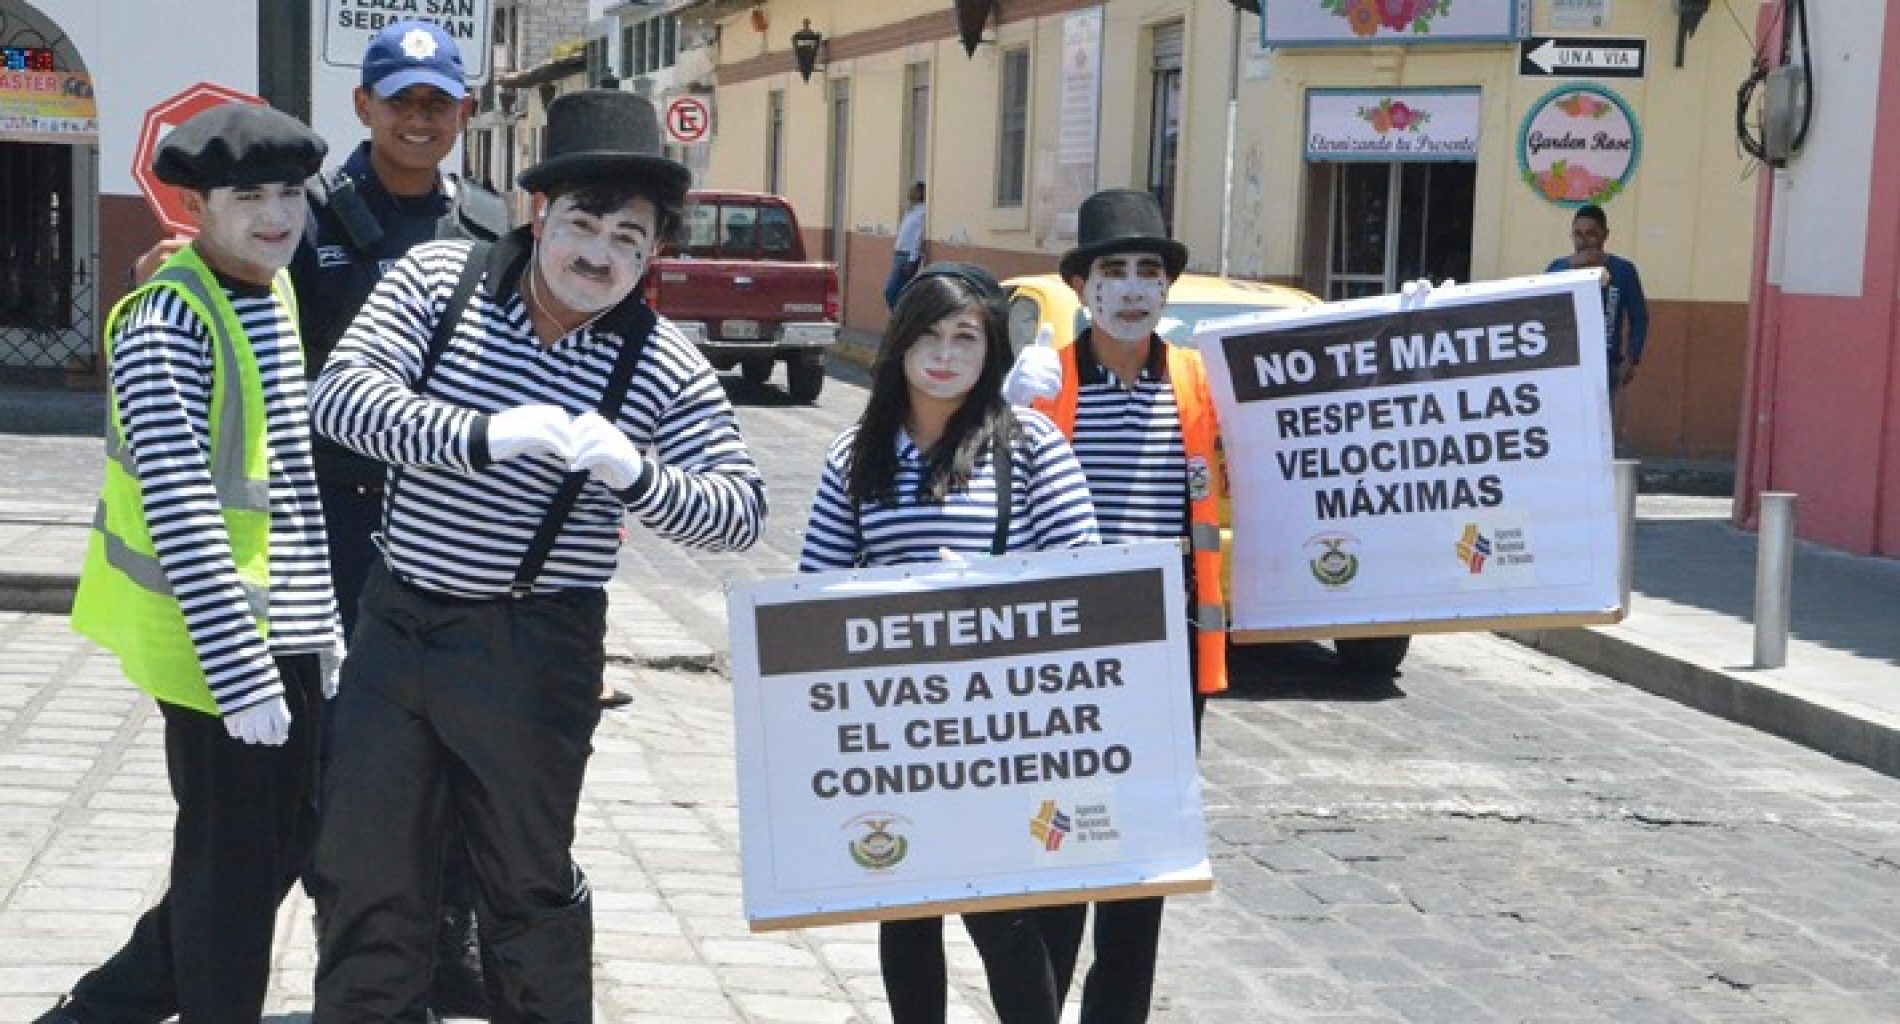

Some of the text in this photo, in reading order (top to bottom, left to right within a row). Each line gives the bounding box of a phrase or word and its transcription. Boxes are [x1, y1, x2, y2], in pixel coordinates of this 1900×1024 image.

[1559, 48, 1594, 65] UNA
[1528, 130, 1631, 155] Garden Rose
[1253, 319, 1549, 388] NO TE MATES
[1276, 382, 1541, 439] RESPETA LAS
[1275, 425, 1550, 481] VELOCIDADES
[1315, 473, 1504, 521] MÁXIMAS
[846, 598, 1082, 654] DETENTE
[809, 657, 1124, 712] SI VAS A USAR
[837, 703, 1103, 753] EL CELULAR
[811, 743, 1133, 798] CONDUCIENDO
